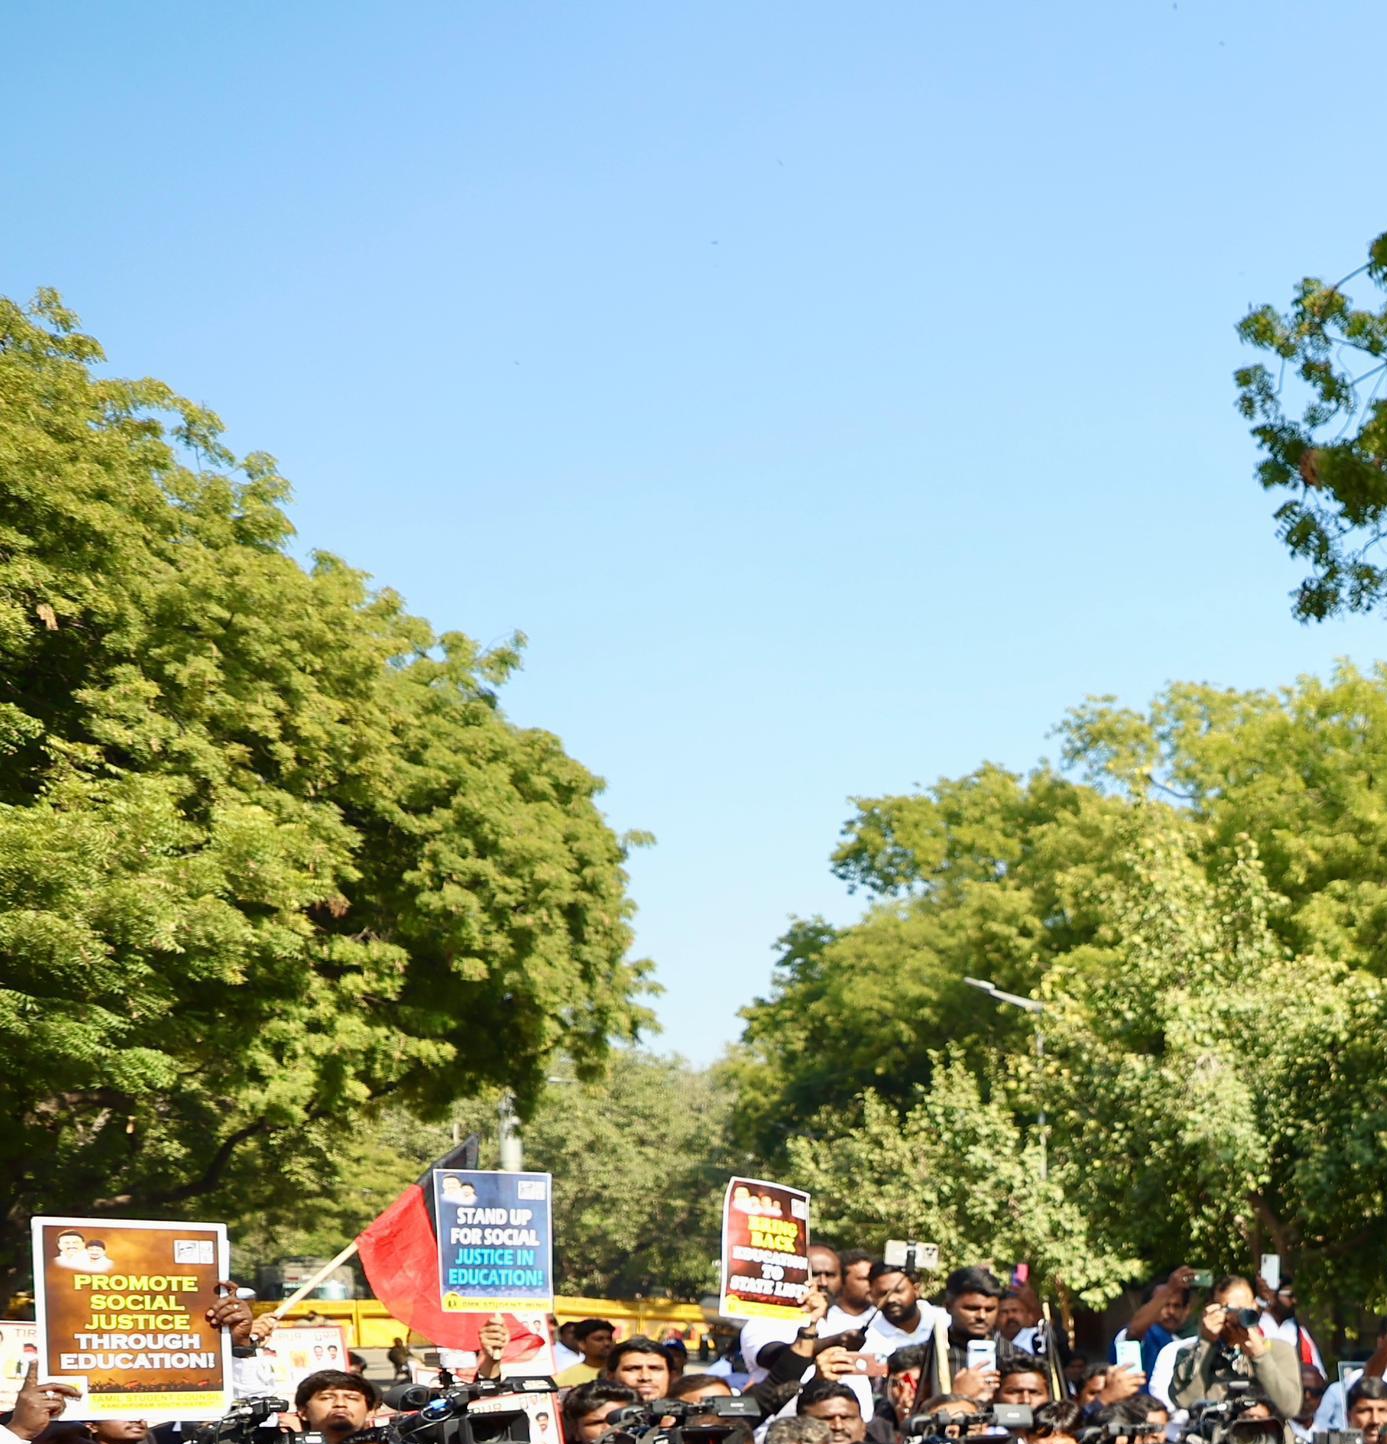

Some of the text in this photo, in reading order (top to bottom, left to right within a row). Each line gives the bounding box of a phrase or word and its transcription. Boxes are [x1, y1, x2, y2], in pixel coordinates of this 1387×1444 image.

[457, 1207, 533, 1225] STAND UP
[747, 1215, 798, 1238] BRING
[450, 1228, 540, 1246] FOR SOCIAL
[751, 1231, 796, 1253] BACK
[455, 1248, 534, 1266] JUSTICE IN
[448, 1268, 544, 1286] EDUCATION!
[761, 1263, 784, 1281] TO
[73, 1274, 198, 1292] PROMOTE
[90, 1294, 186, 1311] SOCIAL
[84, 1313, 191, 1330] JUSTICE
[74, 1333, 201, 1350] THROUGH
[59, 1352, 216, 1370] EDUCATION!
